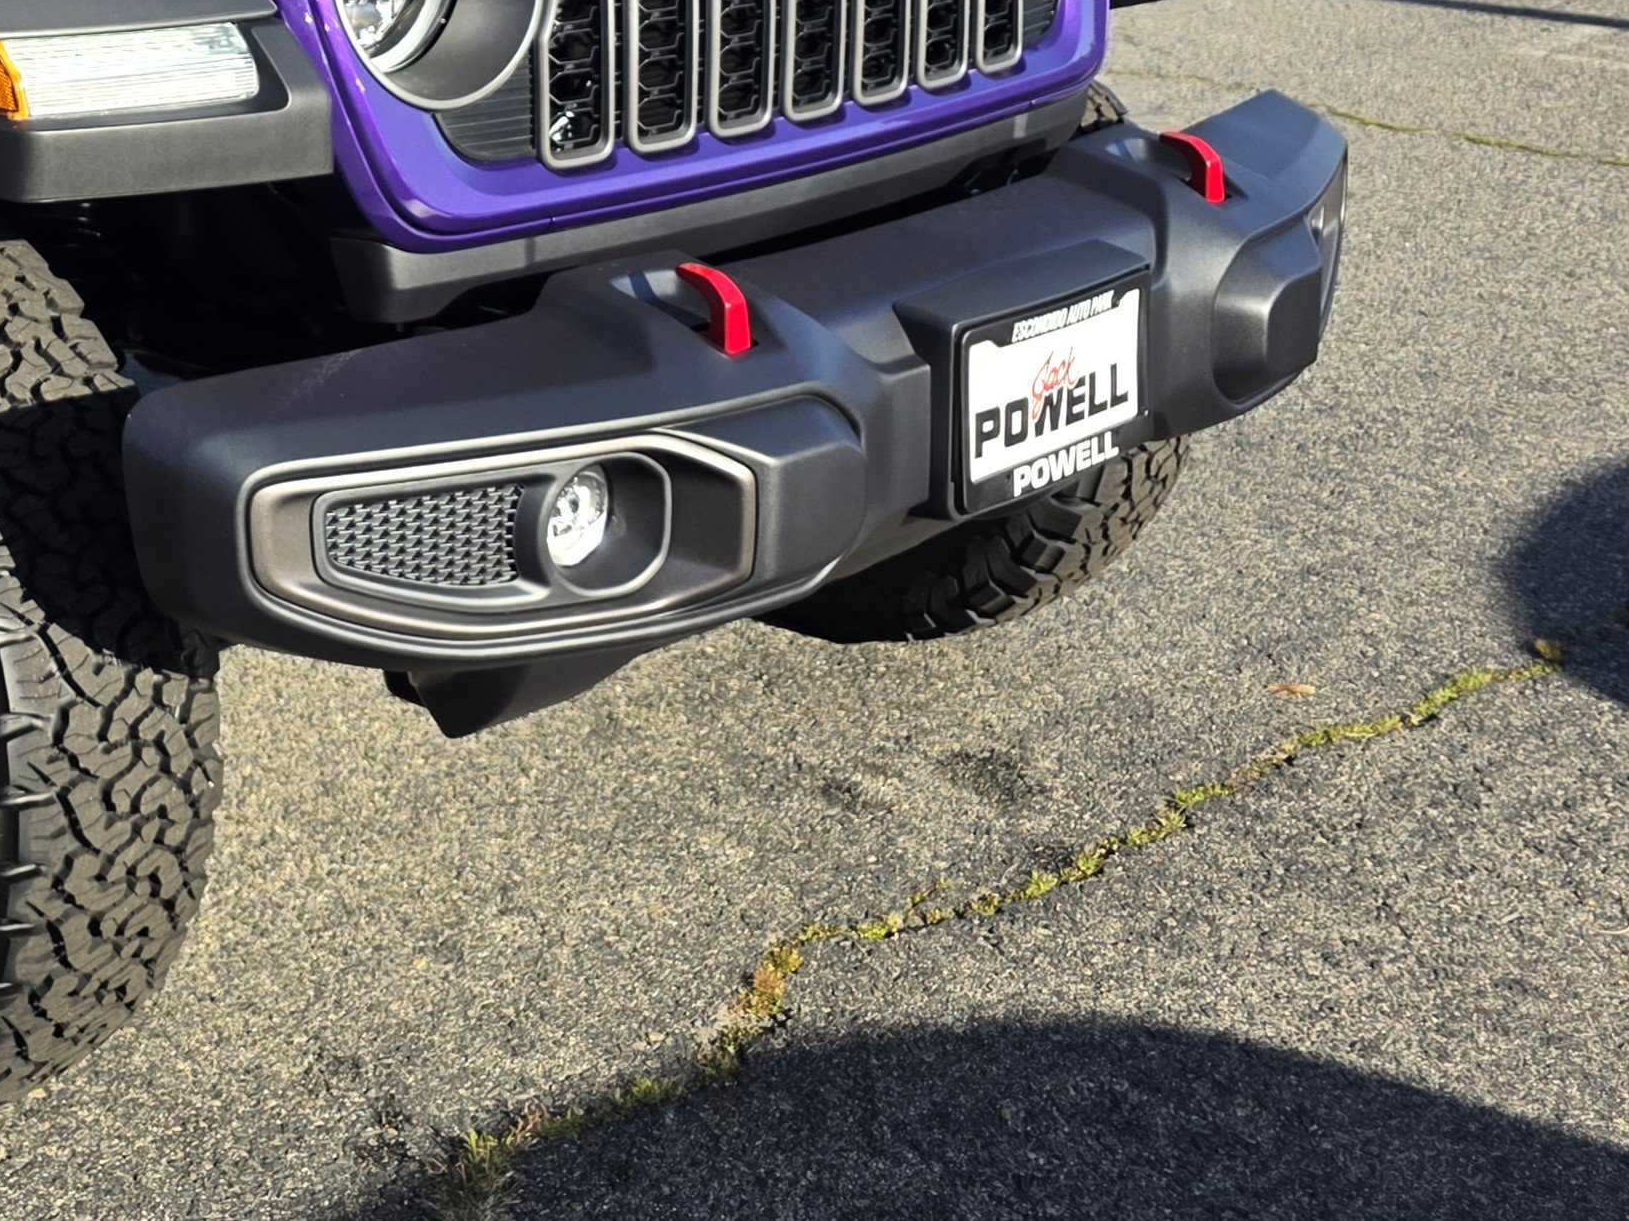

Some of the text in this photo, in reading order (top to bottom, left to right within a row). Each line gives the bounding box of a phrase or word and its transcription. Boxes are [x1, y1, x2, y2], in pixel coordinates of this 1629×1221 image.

[1011, 290, 1115, 343] ESCONDIDO AUTO PARK
[974, 362, 1129, 460] POWELL
[1031, 345, 1082, 421] Jack
[1013, 431, 1120, 497] POWELL
